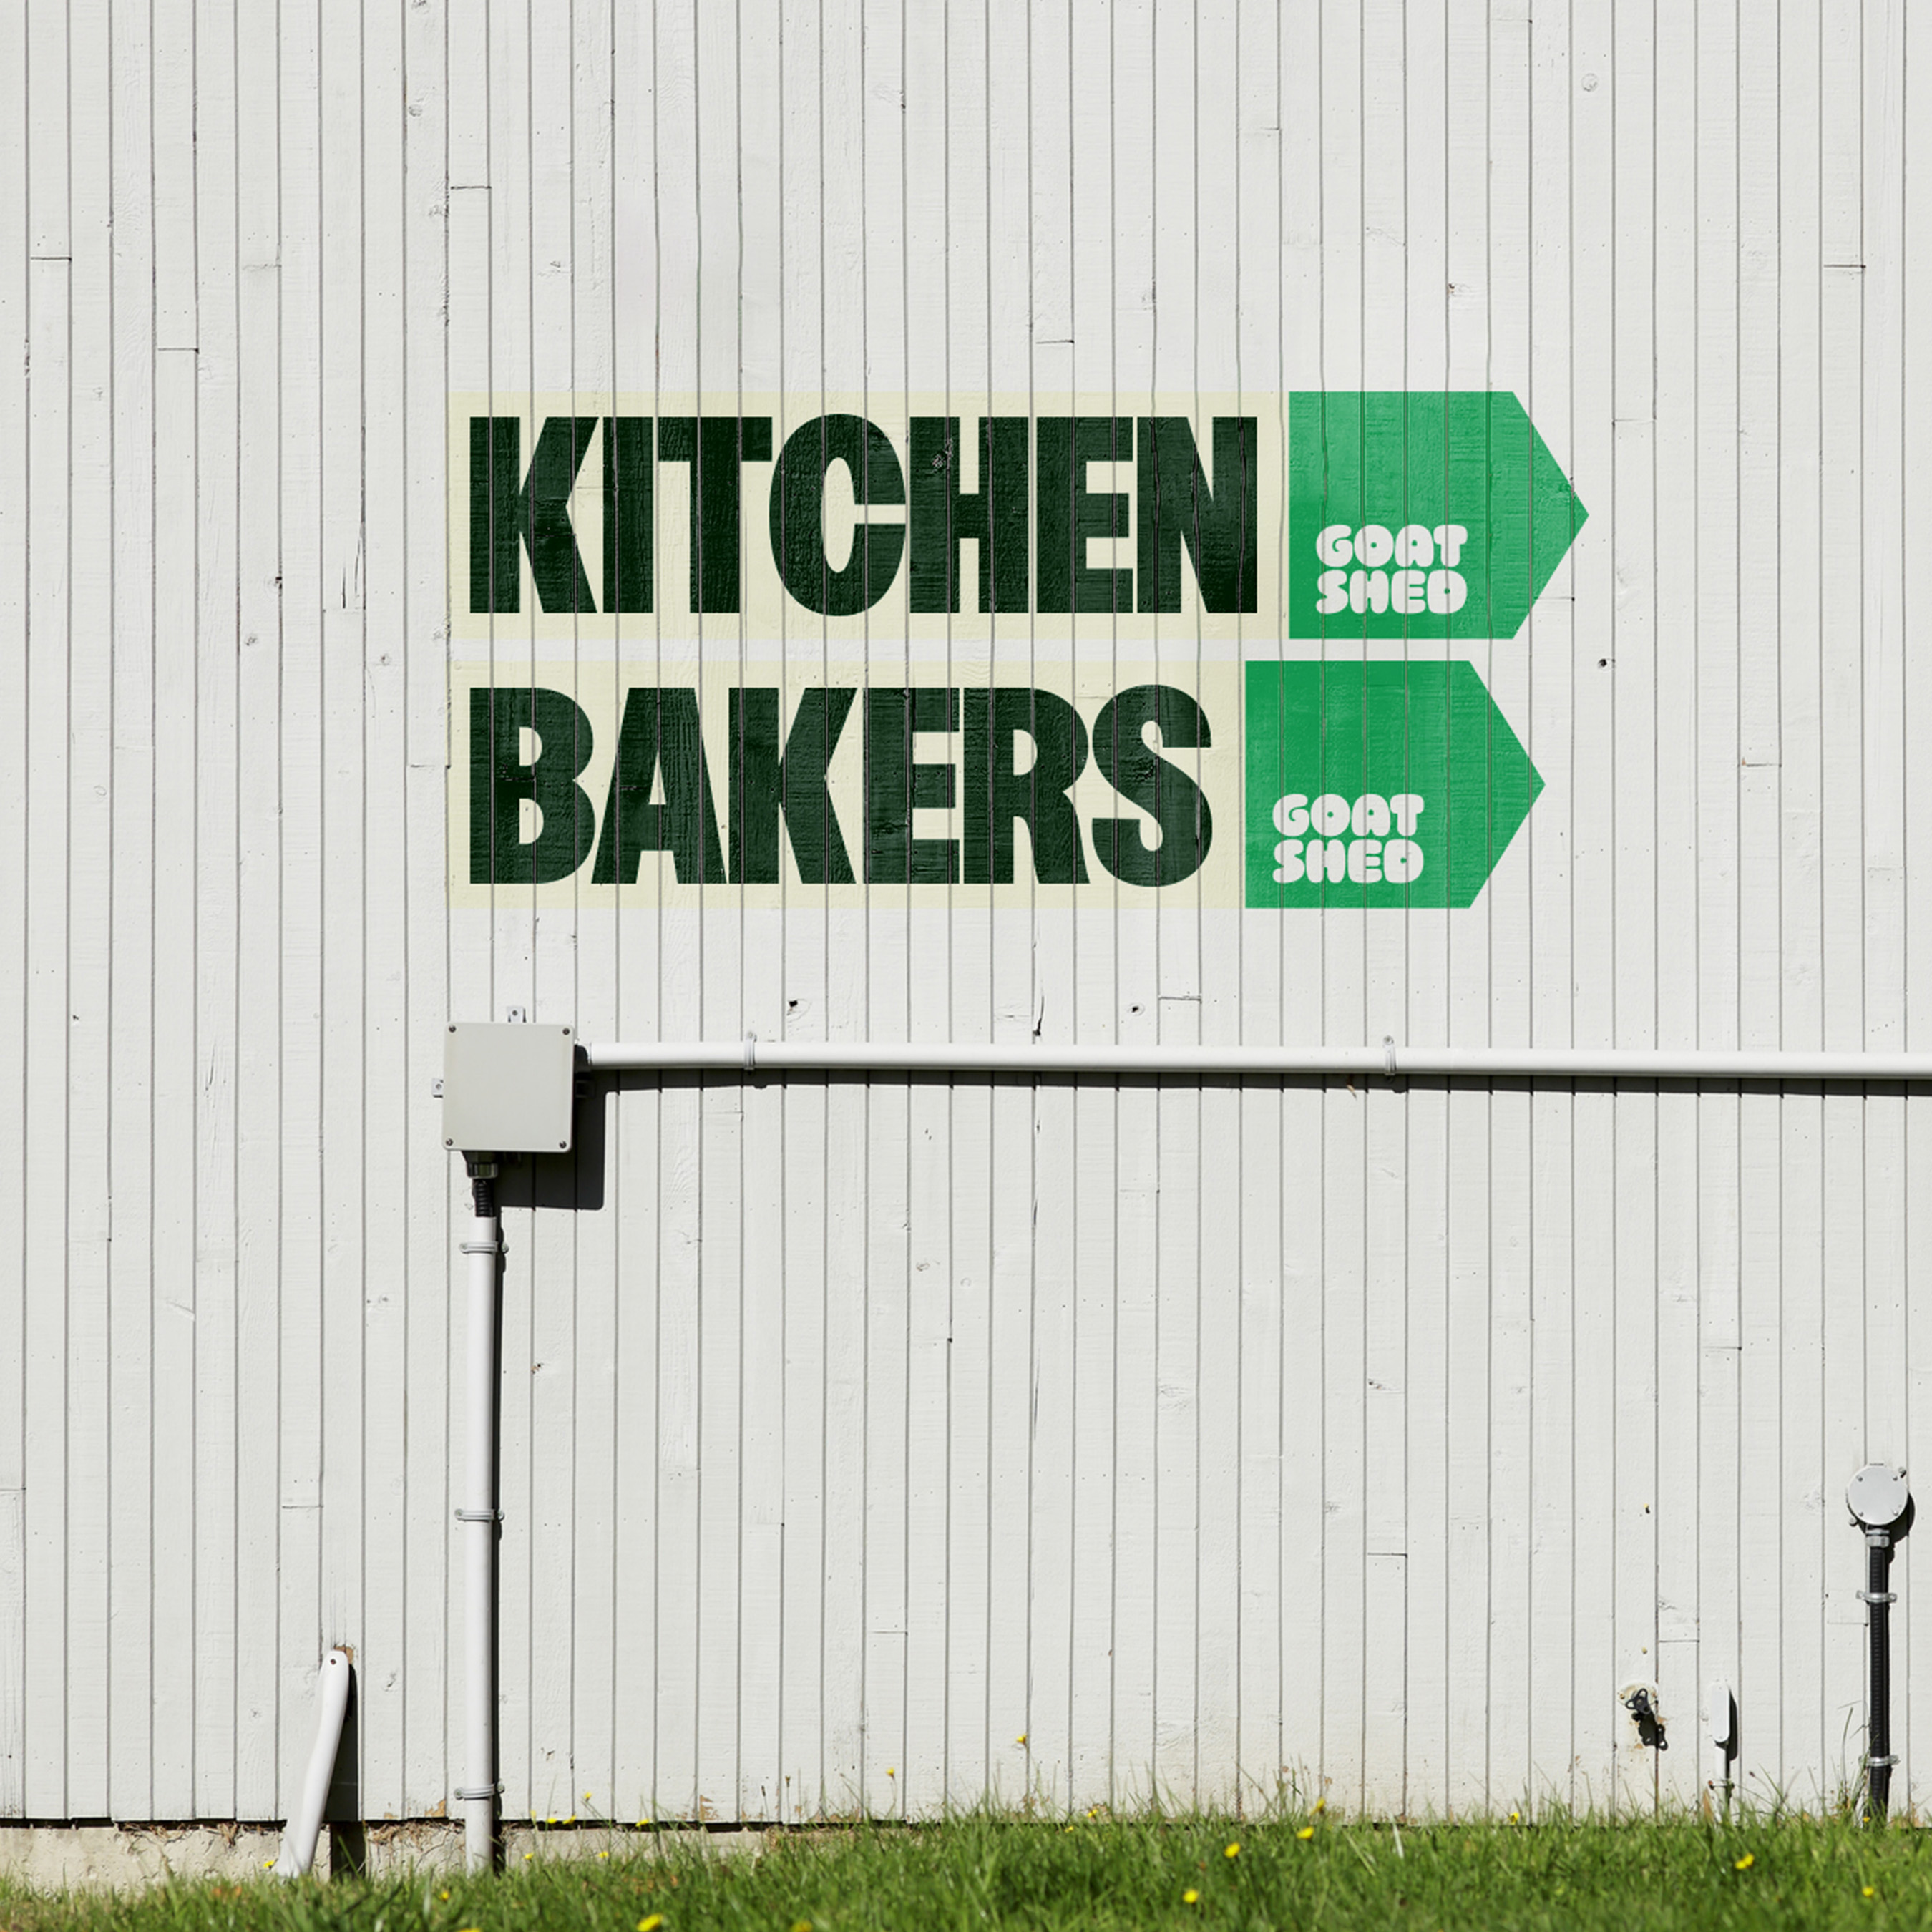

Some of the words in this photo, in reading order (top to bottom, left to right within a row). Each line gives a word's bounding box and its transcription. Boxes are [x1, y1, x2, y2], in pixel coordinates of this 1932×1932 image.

[470, 414, 1258, 617] KITCHEN
[1316, 524, 1468, 567] GOAT
[1316, 570, 1468, 614] SHED
[470, 685, 1213, 887] BAKERS
[1272, 794, 1424, 837] GOAT
[1272, 839, 1424, 884] SHED
